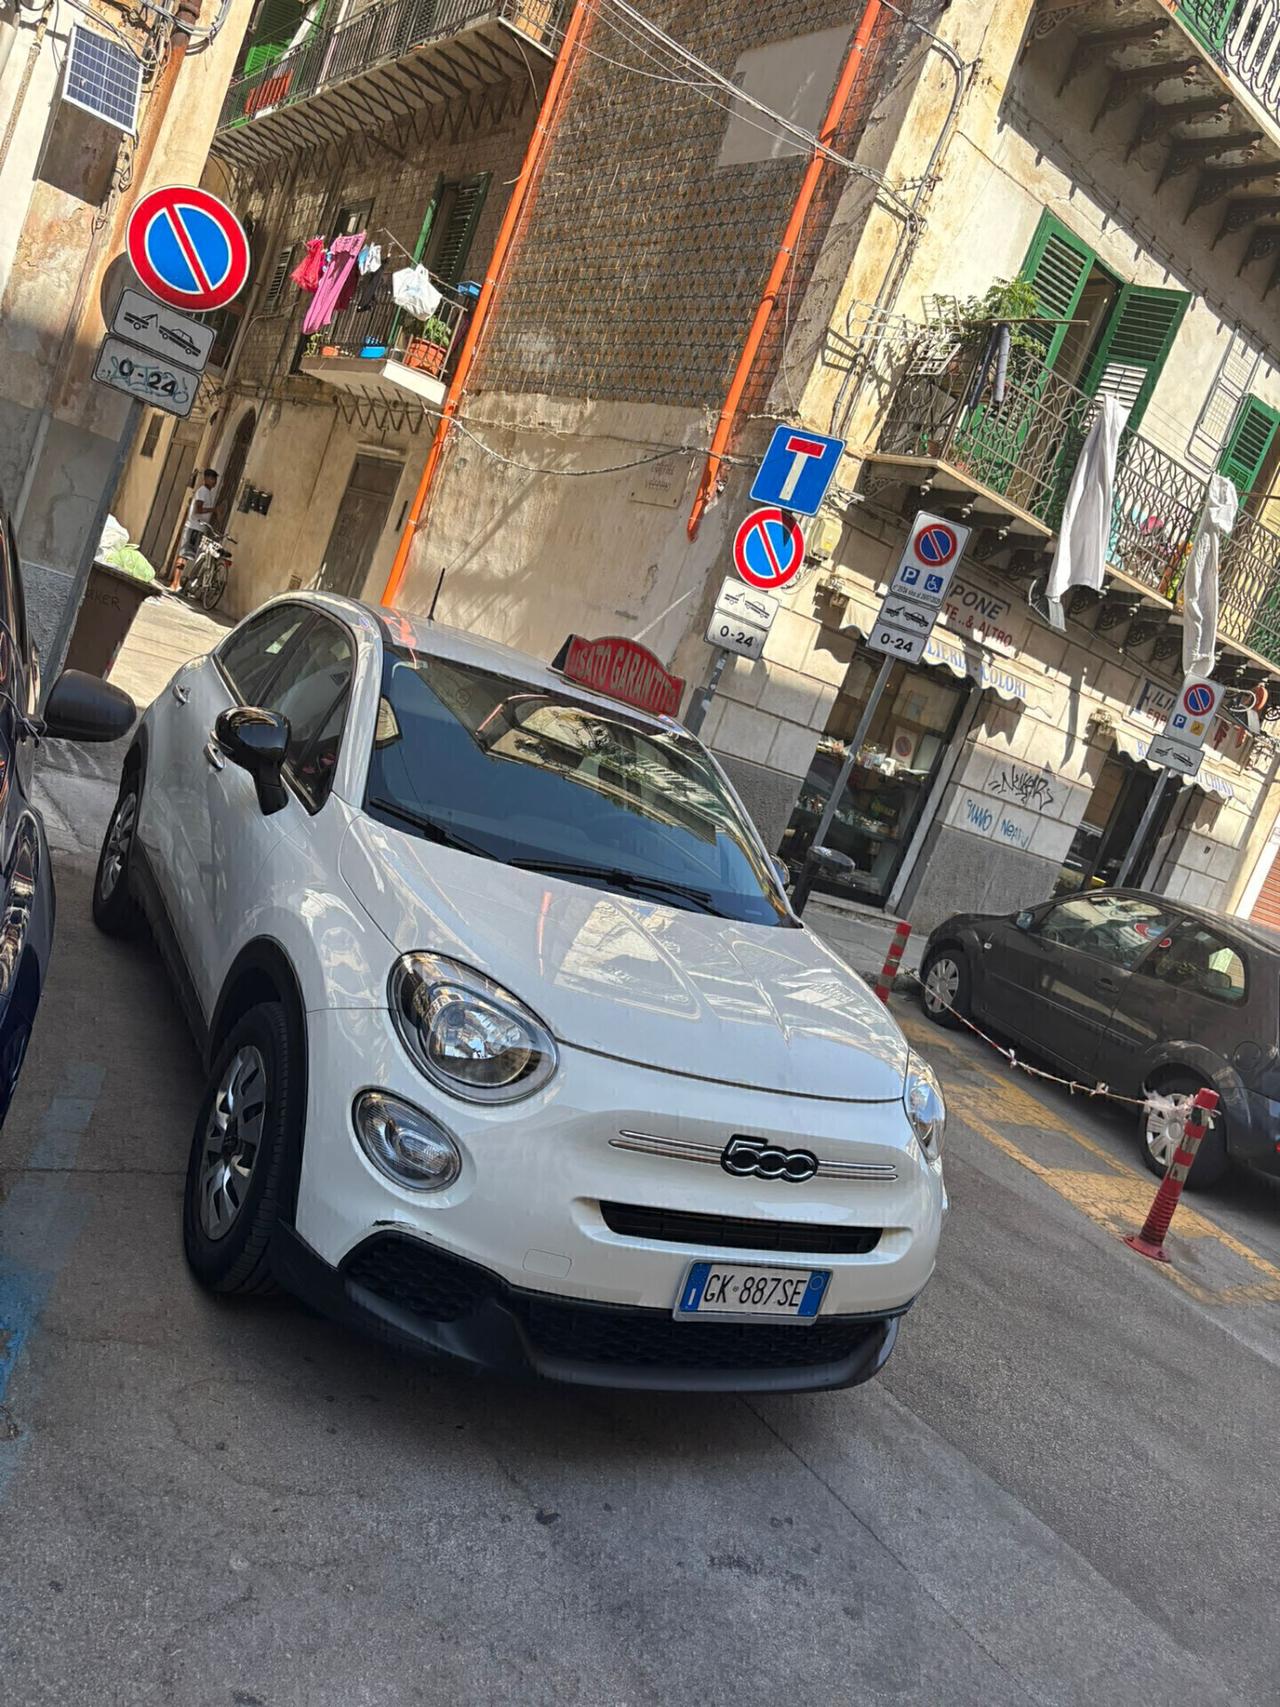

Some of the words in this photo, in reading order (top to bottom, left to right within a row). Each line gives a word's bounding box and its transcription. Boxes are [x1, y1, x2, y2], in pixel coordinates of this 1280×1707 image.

[949, 582, 1003, 621] PONE
[720, 625, 754, 647] 0-24
[880, 632, 915, 654] 0-24
[978, 621, 1013, 648] ALTRO
[611, 646, 677, 713] GARANTITO
[723, 1136, 816, 1180] 500
[703, 1273, 735, 1304] GK
[739, 1276, 808, 1308] 887SE
